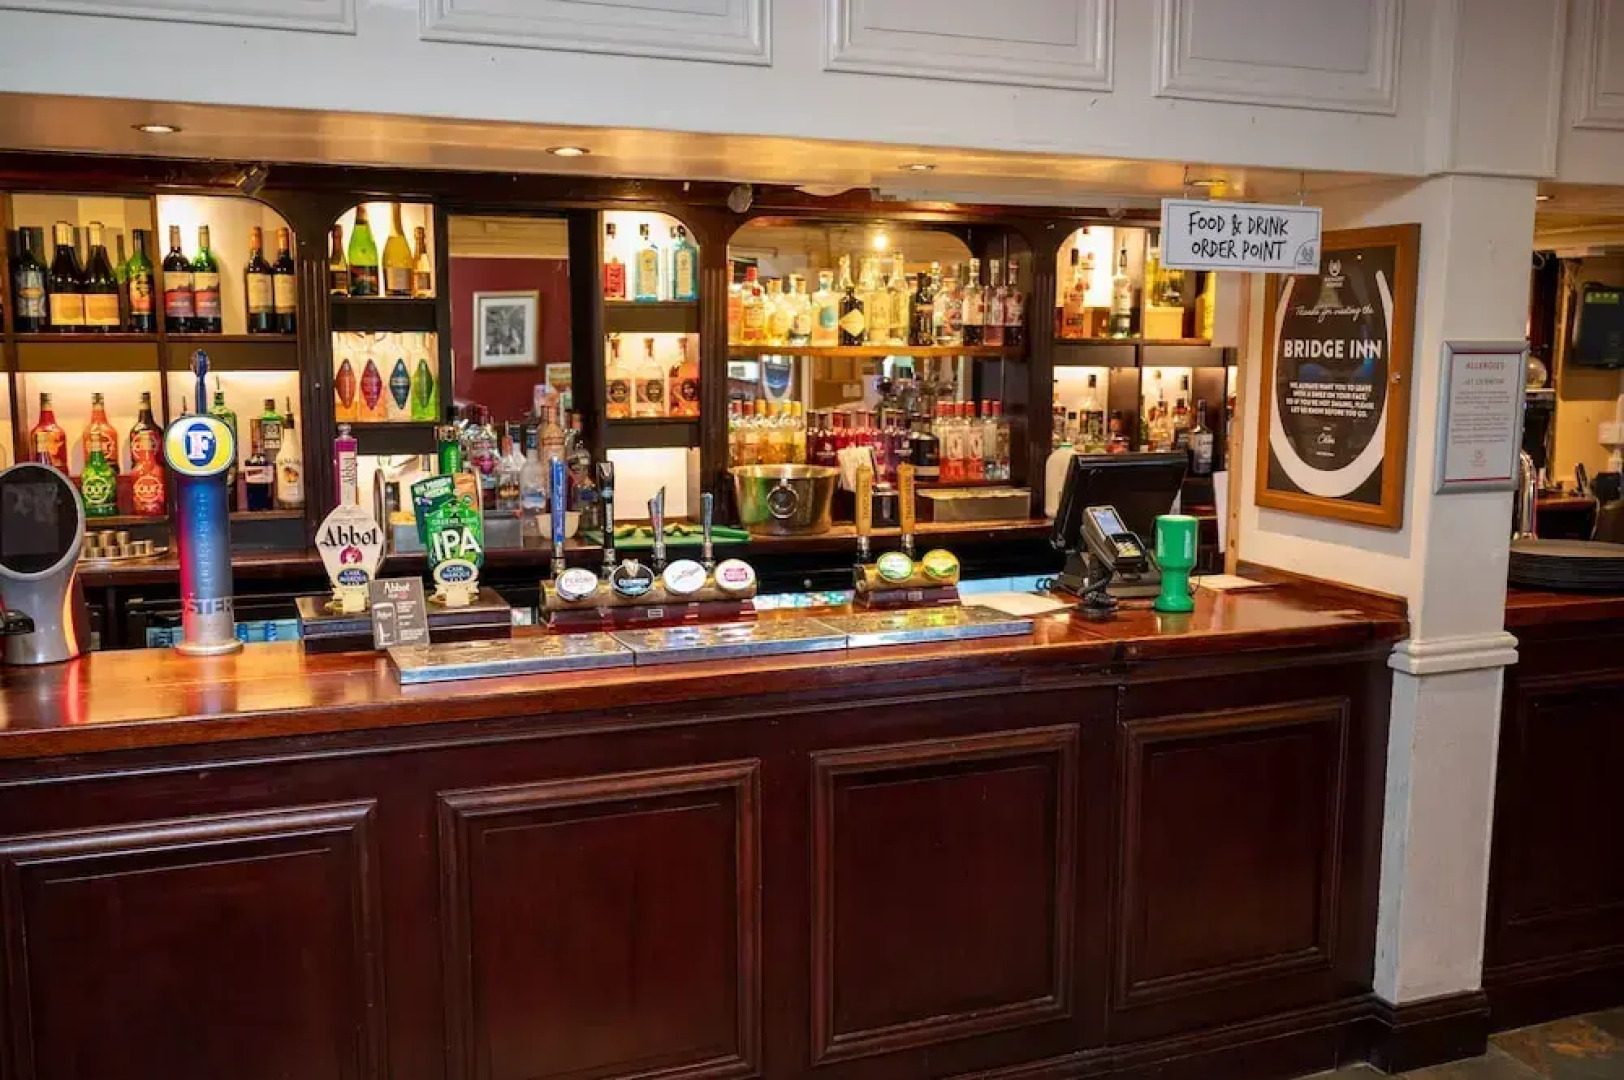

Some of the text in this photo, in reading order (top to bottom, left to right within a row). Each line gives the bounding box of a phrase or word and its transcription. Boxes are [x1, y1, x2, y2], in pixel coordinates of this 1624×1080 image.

[1189, 211, 1289, 237] FOOD & DRINK
[1191, 238, 1287, 261] ORDER POINT
[1284, 339, 1383, 359] BRIDGE INN
[187, 431, 214, 461] F
[320, 525, 378, 547] Abbot
[431, 527, 482, 562] IPA
[182, 596, 234, 616] STER
